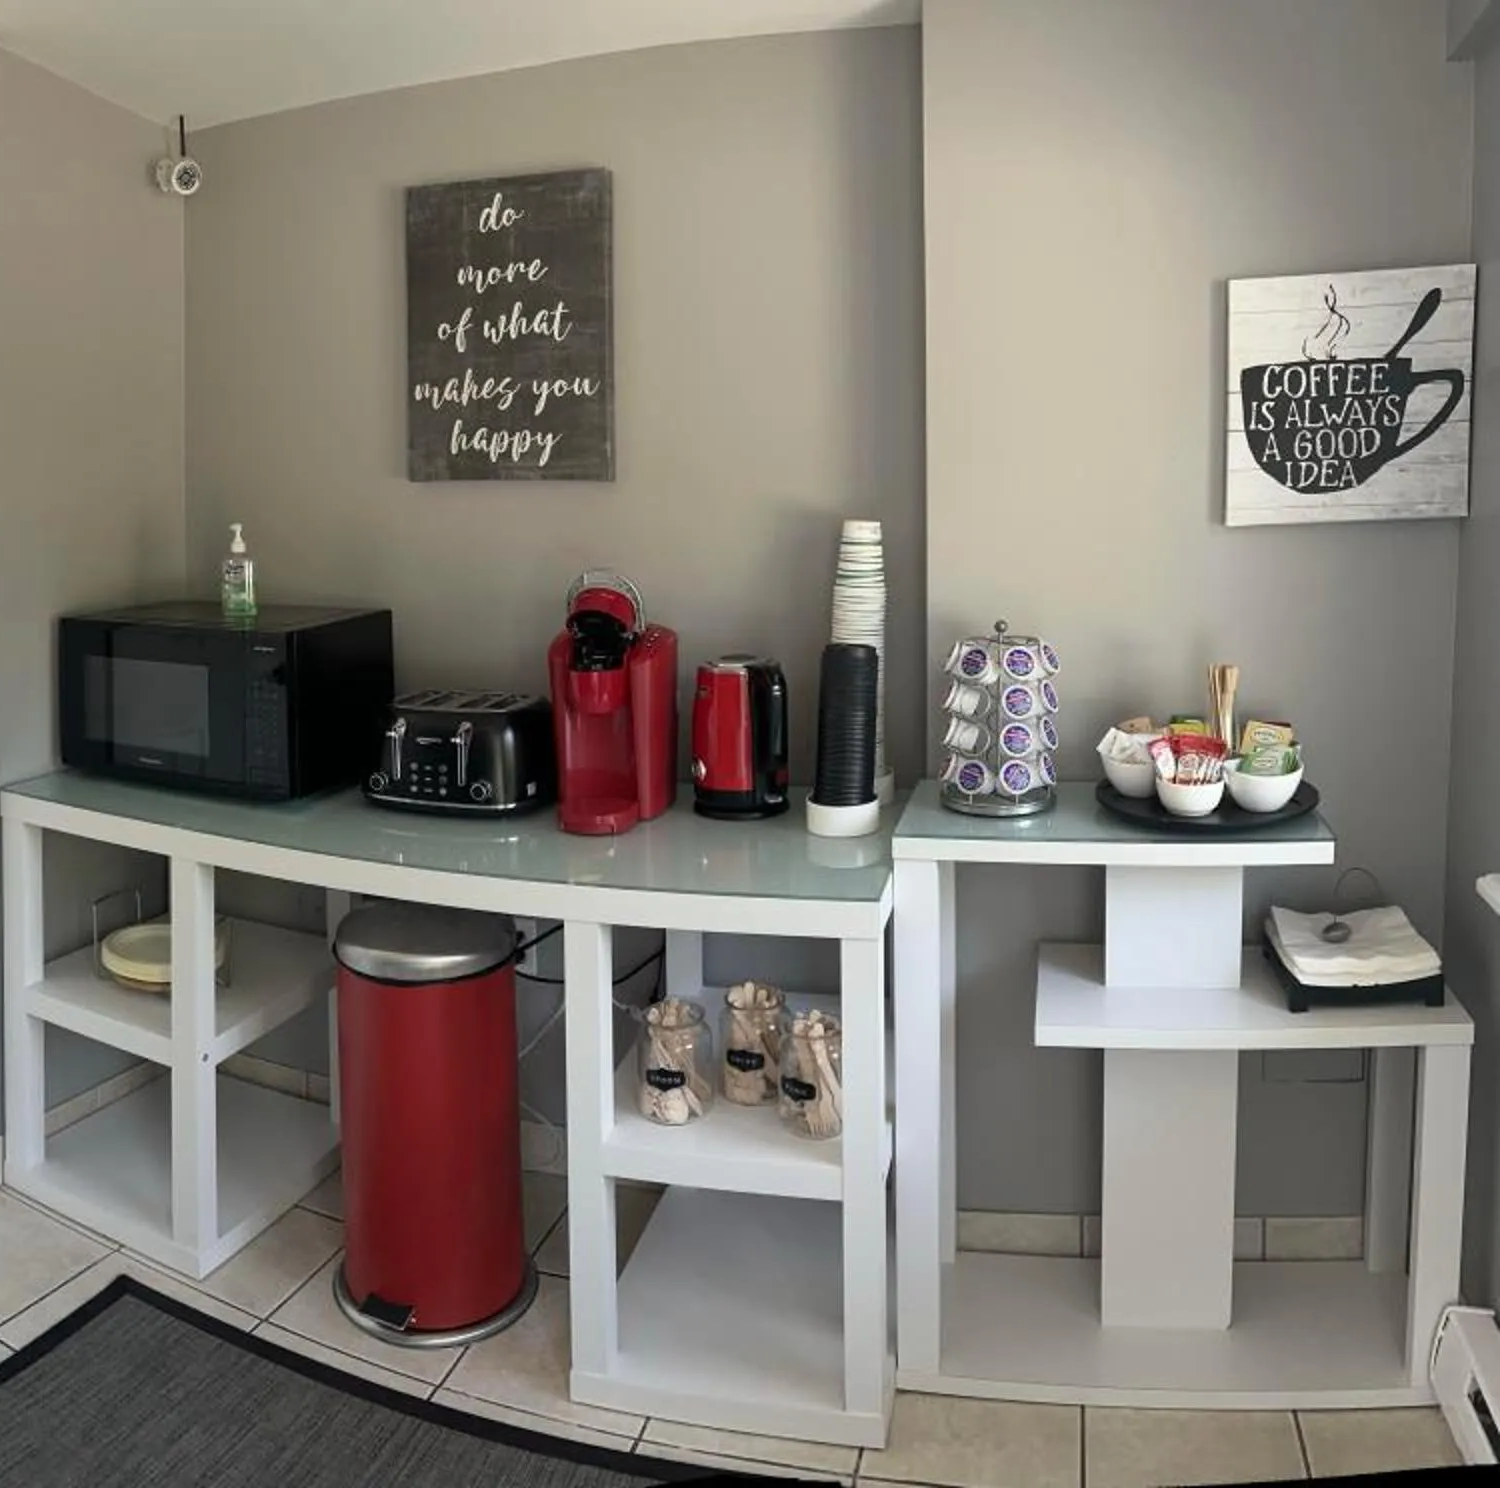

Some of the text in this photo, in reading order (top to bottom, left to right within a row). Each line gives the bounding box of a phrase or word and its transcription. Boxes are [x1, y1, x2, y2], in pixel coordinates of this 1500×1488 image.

[478, 192, 524, 234] do
[457, 258, 548, 294] more
[437, 301, 573, 353] of what
[414, 368, 601, 416] makes you
[1262, 363, 1389, 398] COFFEE
[1249, 395, 1401, 431] IS ALWAYS
[450, 419, 563, 467] happy
[1262, 427, 1381, 462] A GOOD
[1284, 459, 1358, 488] IDEA
